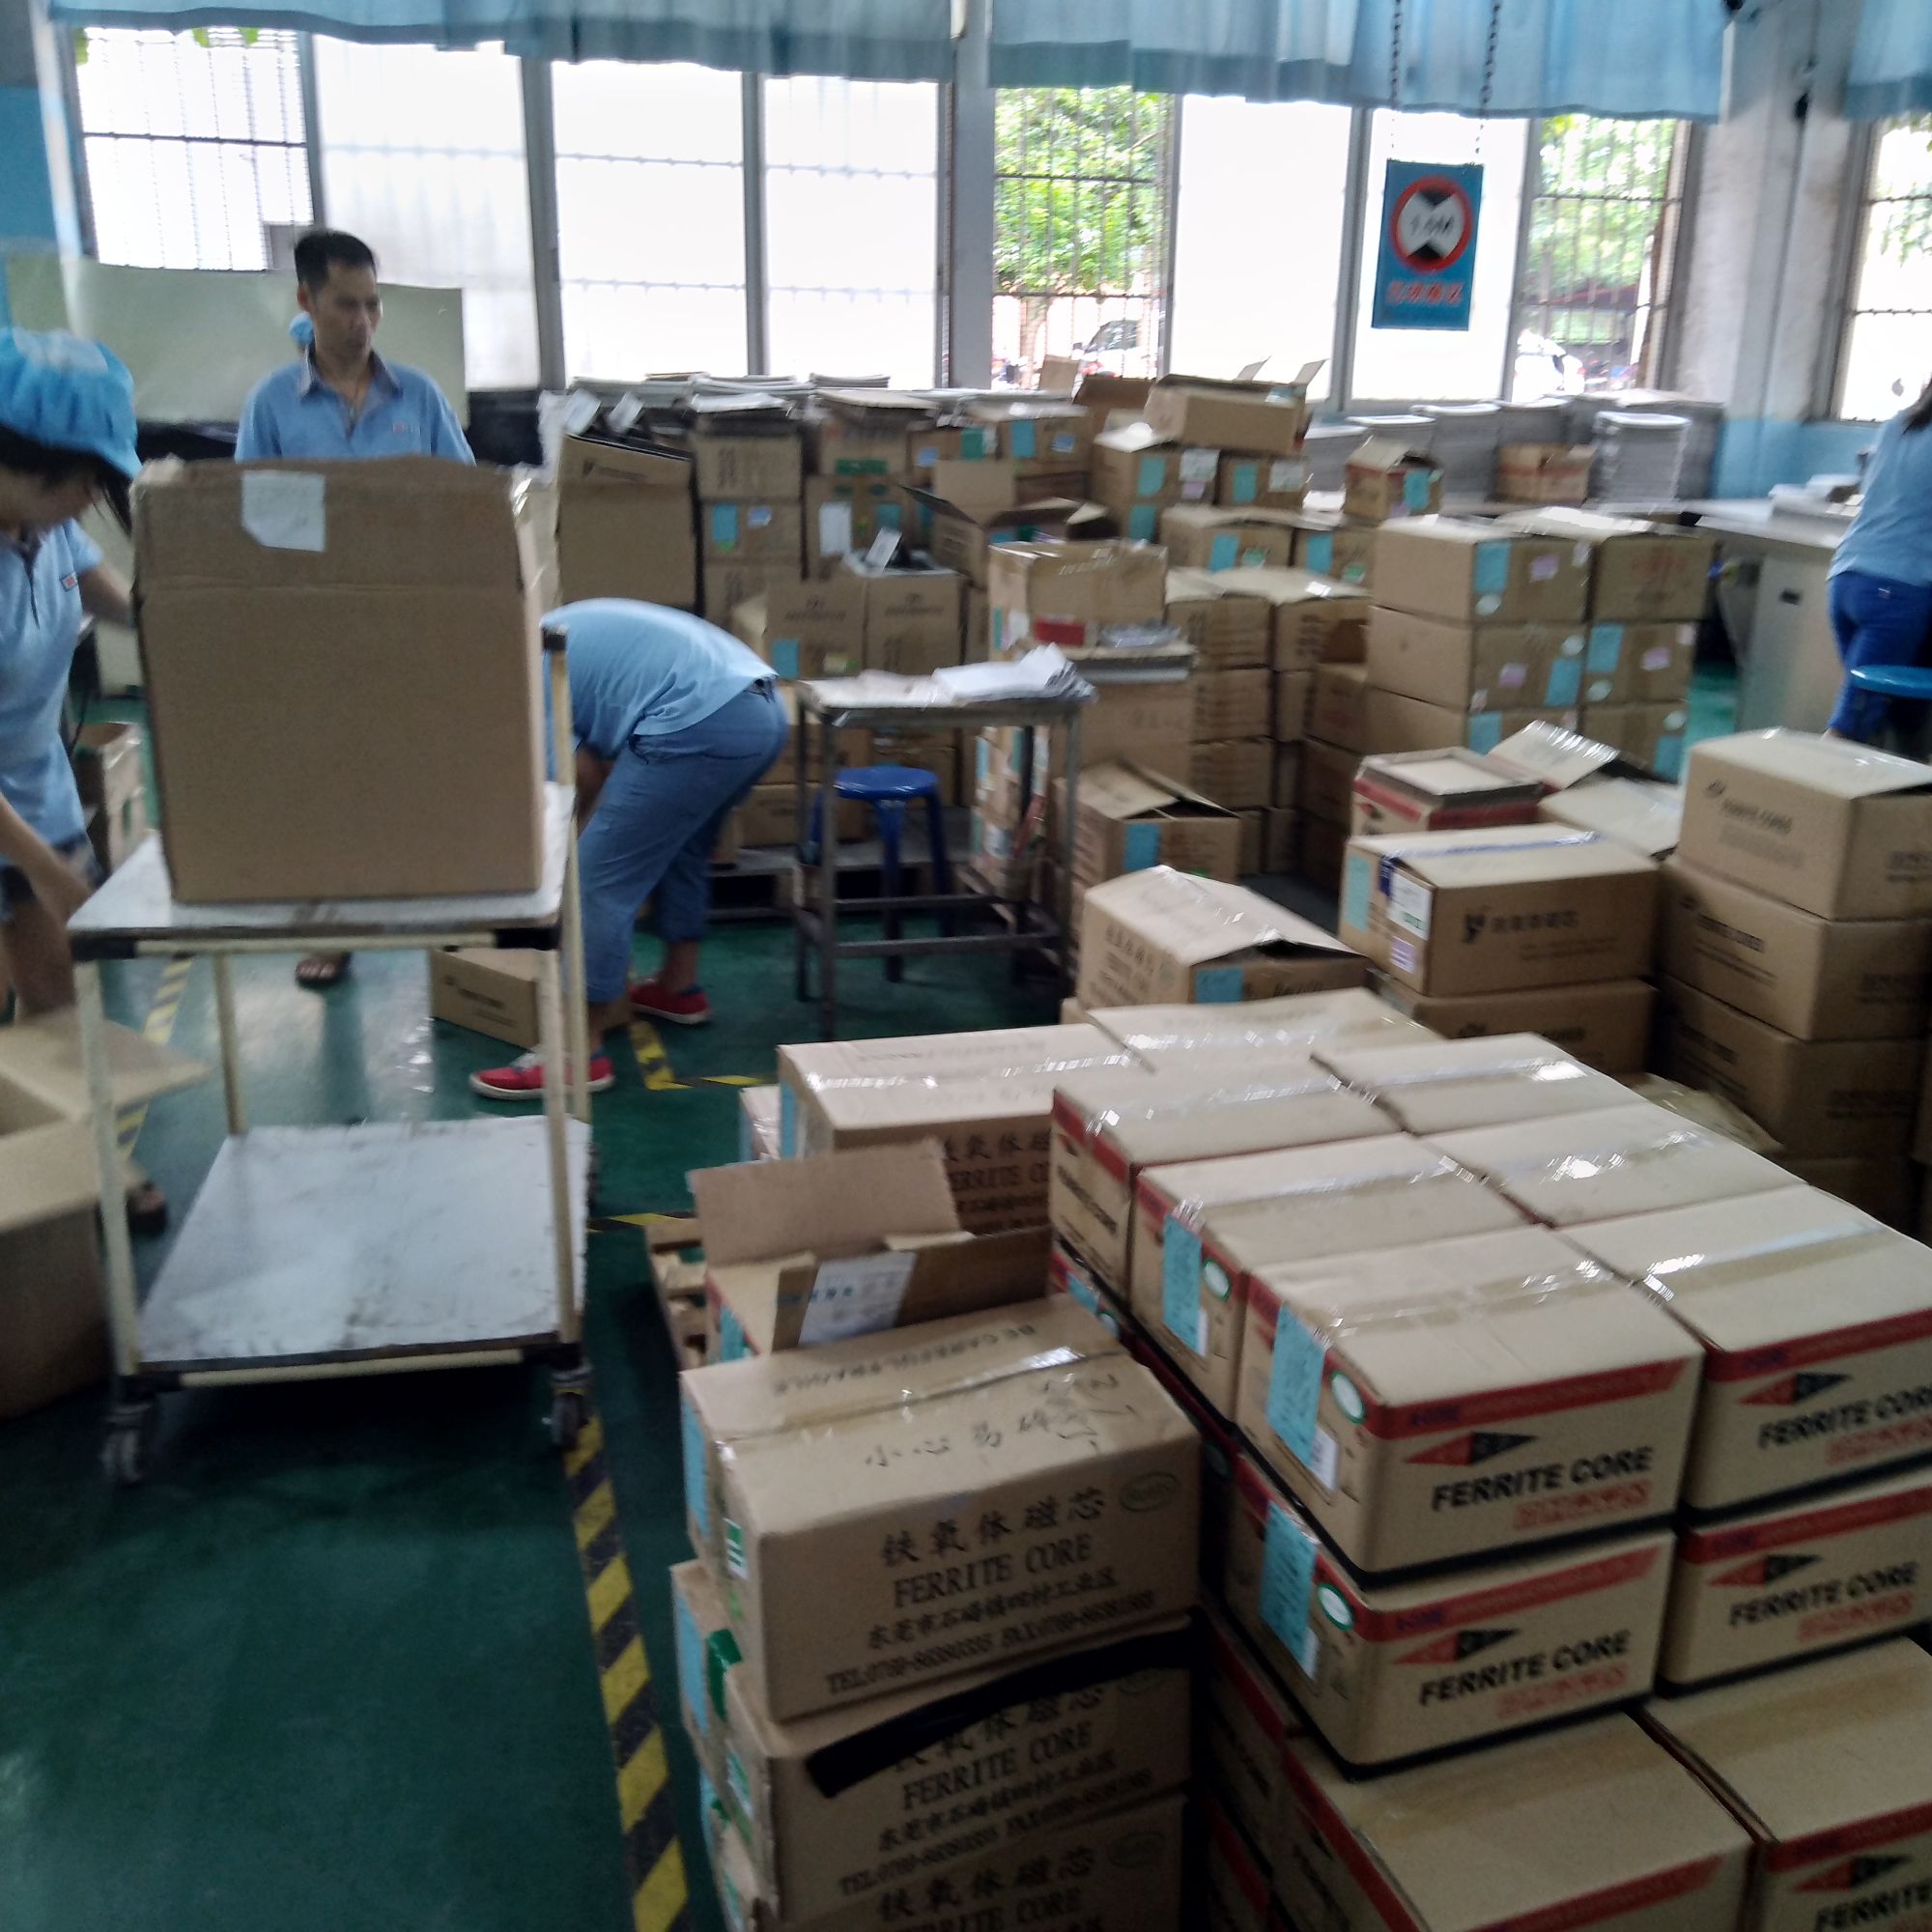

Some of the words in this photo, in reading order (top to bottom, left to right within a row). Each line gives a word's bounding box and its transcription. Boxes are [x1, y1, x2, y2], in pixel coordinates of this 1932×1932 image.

[1757, 1400, 1872, 1449] FERRITE
[1431, 1463, 1565, 1512] FERRITE
[1570, 1446, 1656, 1484] CORE
[893, 1553, 1013, 1608] FERRITE
[1024, 1532, 1094, 1574] CORE
[1728, 1579, 1844, 1628] FERRITE
[1847, 1560, 1919, 1598] CORE
[1418, 1653, 1547, 1707] FERRITE
[1552, 1628, 1632, 1671] CORE
[901, 1747, 1017, 1811] FERRITE
[1029, 1720, 1094, 1765] CORE
[1016, 1887, 1082, 1924] CORE
